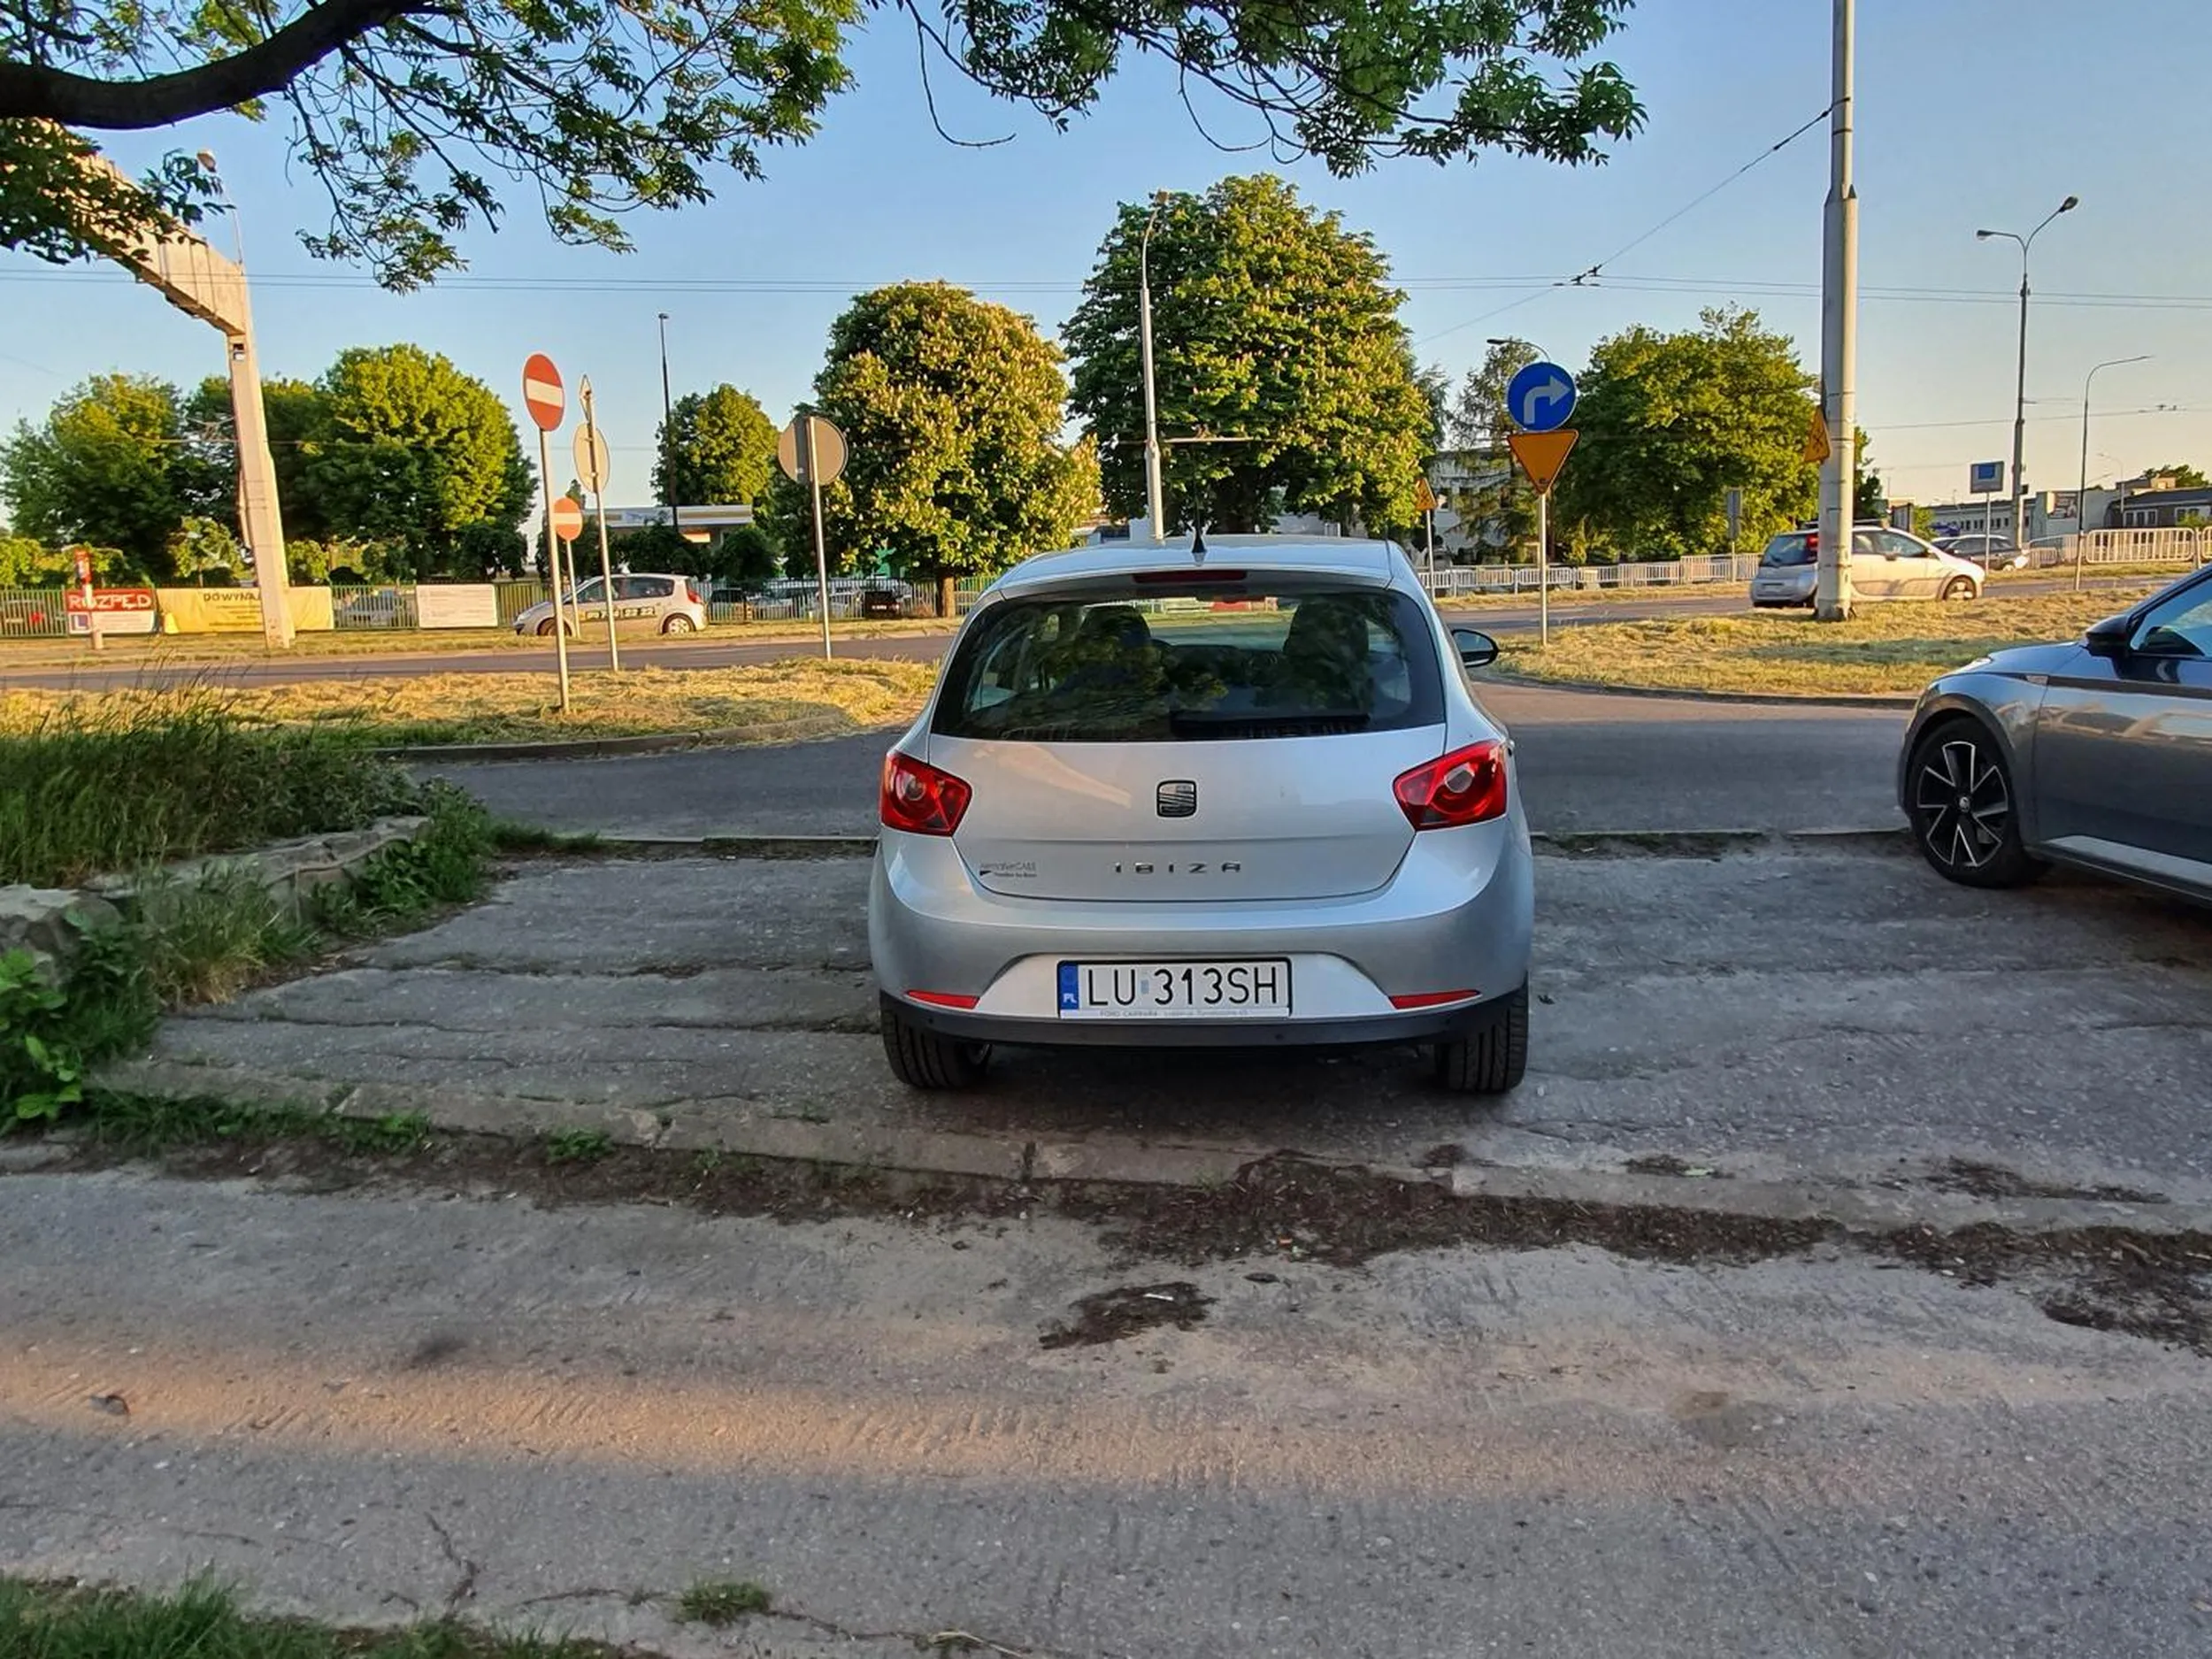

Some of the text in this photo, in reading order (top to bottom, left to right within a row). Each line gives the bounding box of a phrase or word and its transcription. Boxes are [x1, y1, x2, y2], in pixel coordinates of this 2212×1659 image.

[1115, 861, 1241, 874] IBIZA
[1088, 966, 1278, 1006] LU 313SH
[1064, 993, 1078, 1004] PL
